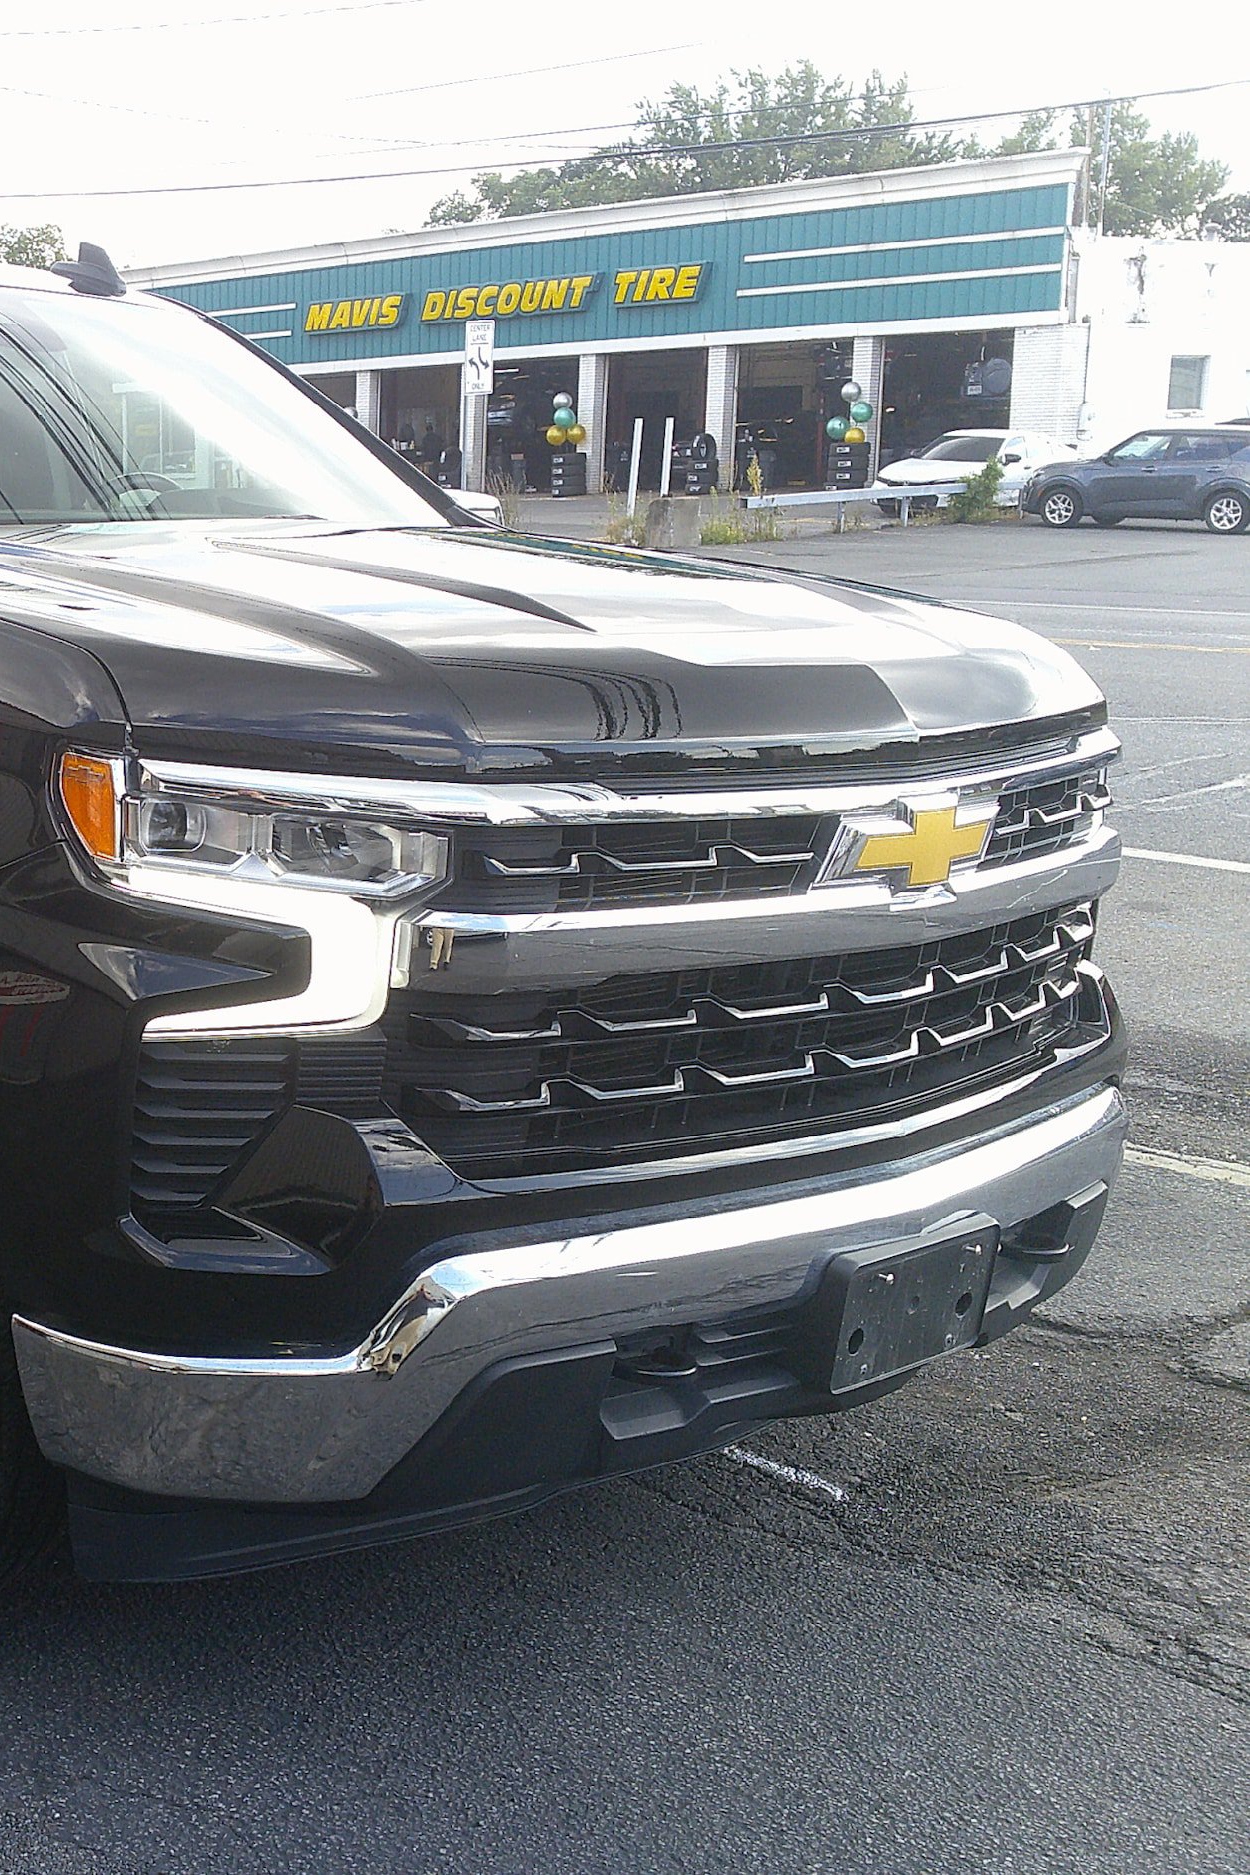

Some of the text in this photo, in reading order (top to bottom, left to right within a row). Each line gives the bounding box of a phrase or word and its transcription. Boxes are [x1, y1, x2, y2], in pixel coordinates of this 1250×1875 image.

[303, 264, 702, 332] MAVIS DISCOUNT TIRE
[472, 333, 487, 341] LANE
